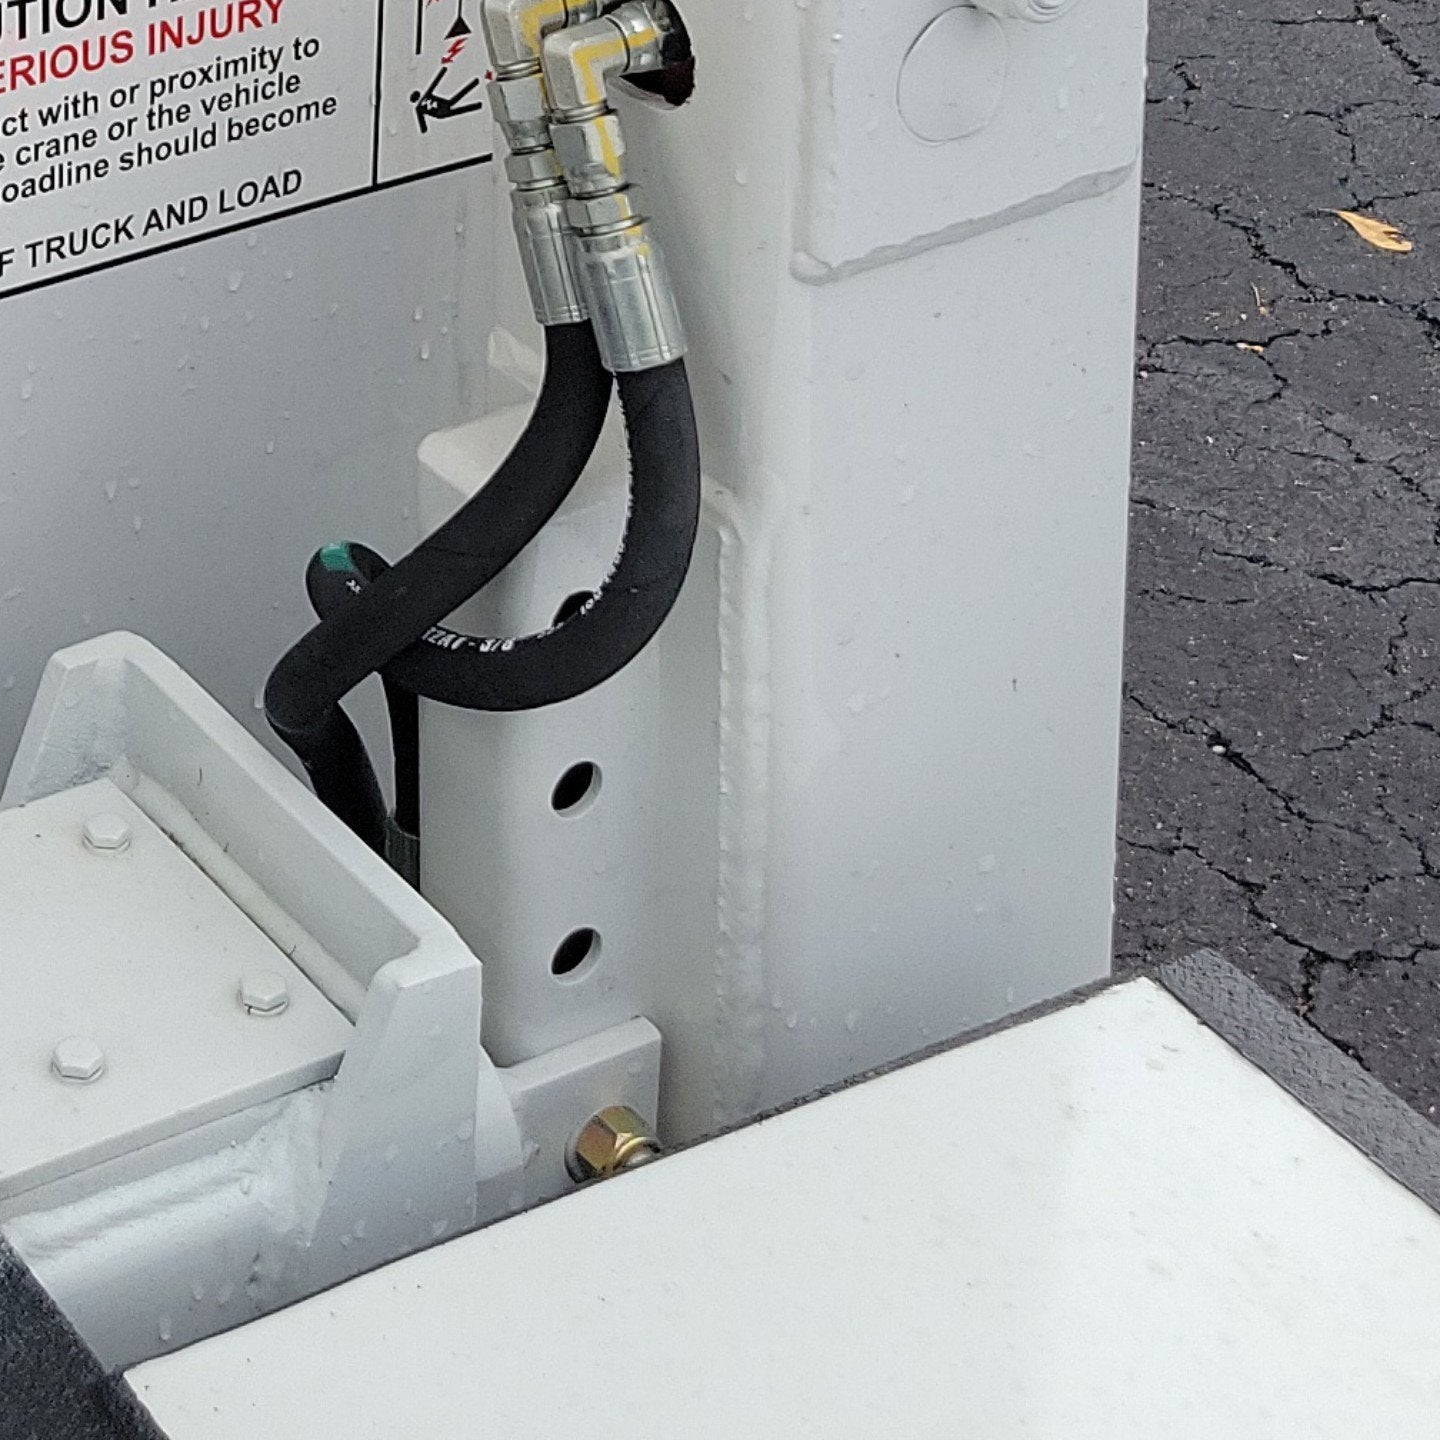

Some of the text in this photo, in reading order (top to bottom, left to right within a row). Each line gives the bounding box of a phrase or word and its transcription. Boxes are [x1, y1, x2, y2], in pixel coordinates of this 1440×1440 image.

[16, 129, 97, 165] crane
[108, 117, 137, 140] or
[147, 104, 190, 131] the
[201, 72, 300, 115] vehicle
[39, 91, 98, 126] with
[110, 84, 140, 108] or
[150, 46, 283, 105] proximity
[293, 37, 319, 60] to
[119, 122, 216, 171] should
[228, 97, 336, 142] become
[25, 215, 134, 267] TRUCK
[143, 196, 207, 236] AND
[220, 170, 301, 214] LOAD
